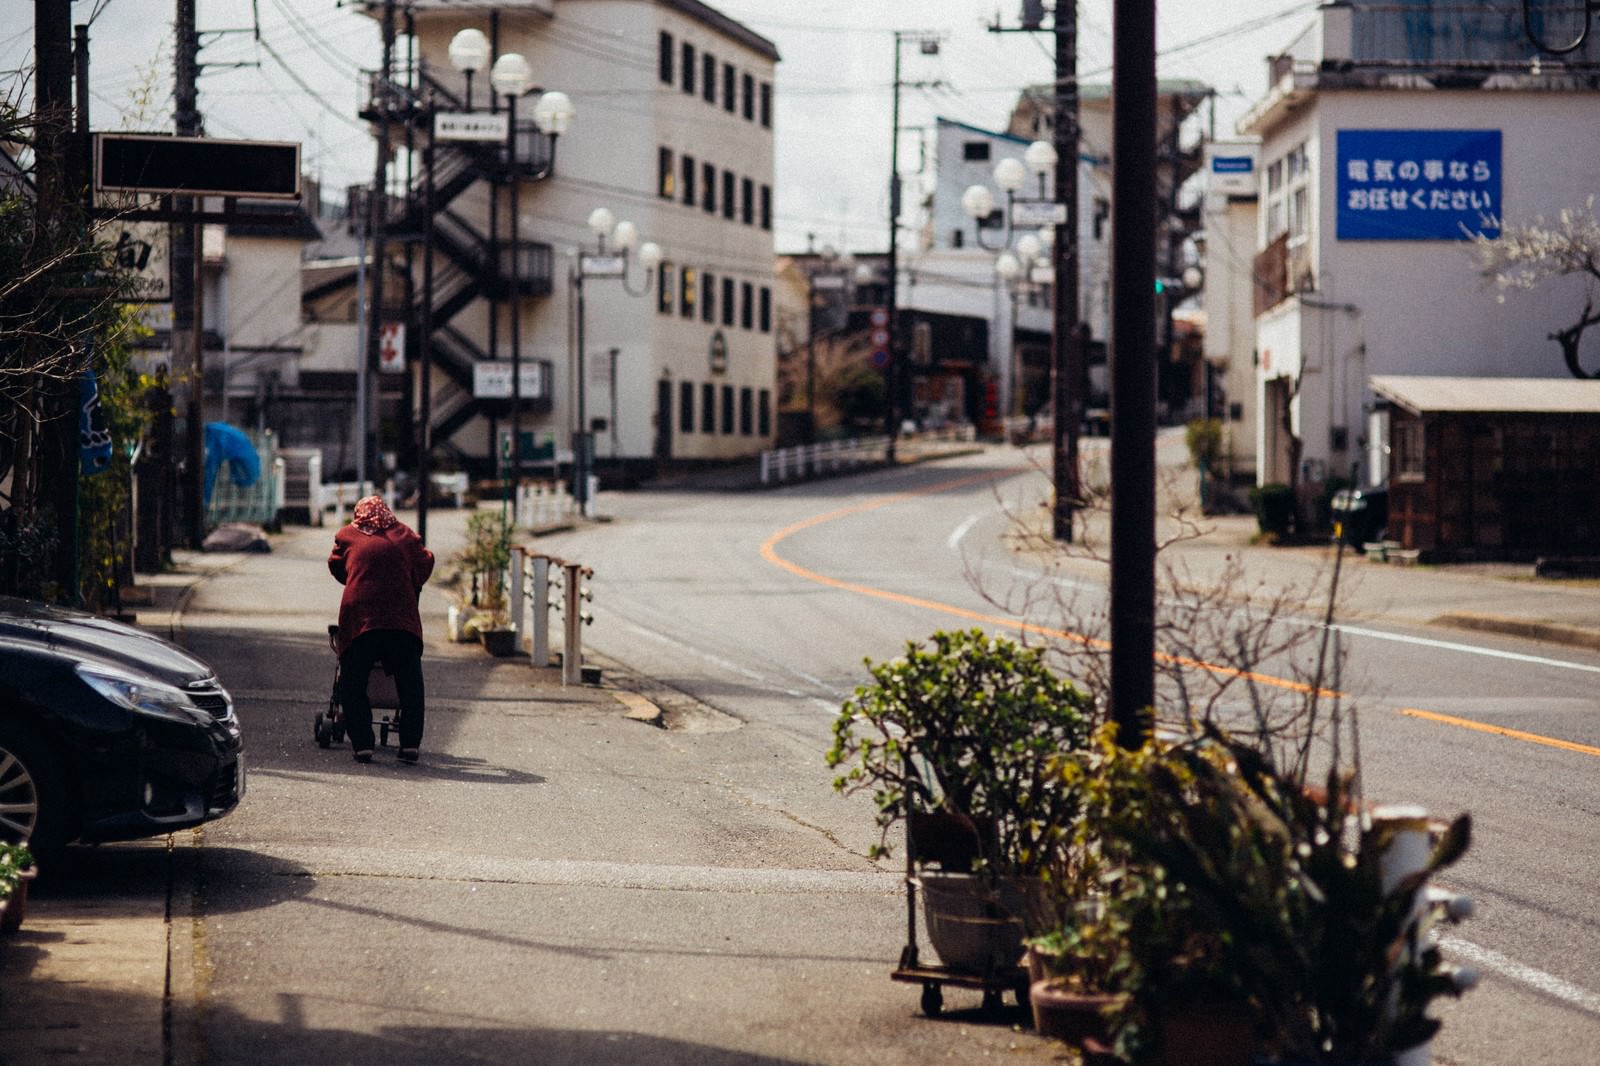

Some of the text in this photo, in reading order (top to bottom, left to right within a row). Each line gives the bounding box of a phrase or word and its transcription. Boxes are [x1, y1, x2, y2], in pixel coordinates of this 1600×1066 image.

[1347, 159, 1491, 182] 電気の事なら
[1347, 188, 1491, 210] お任せください
